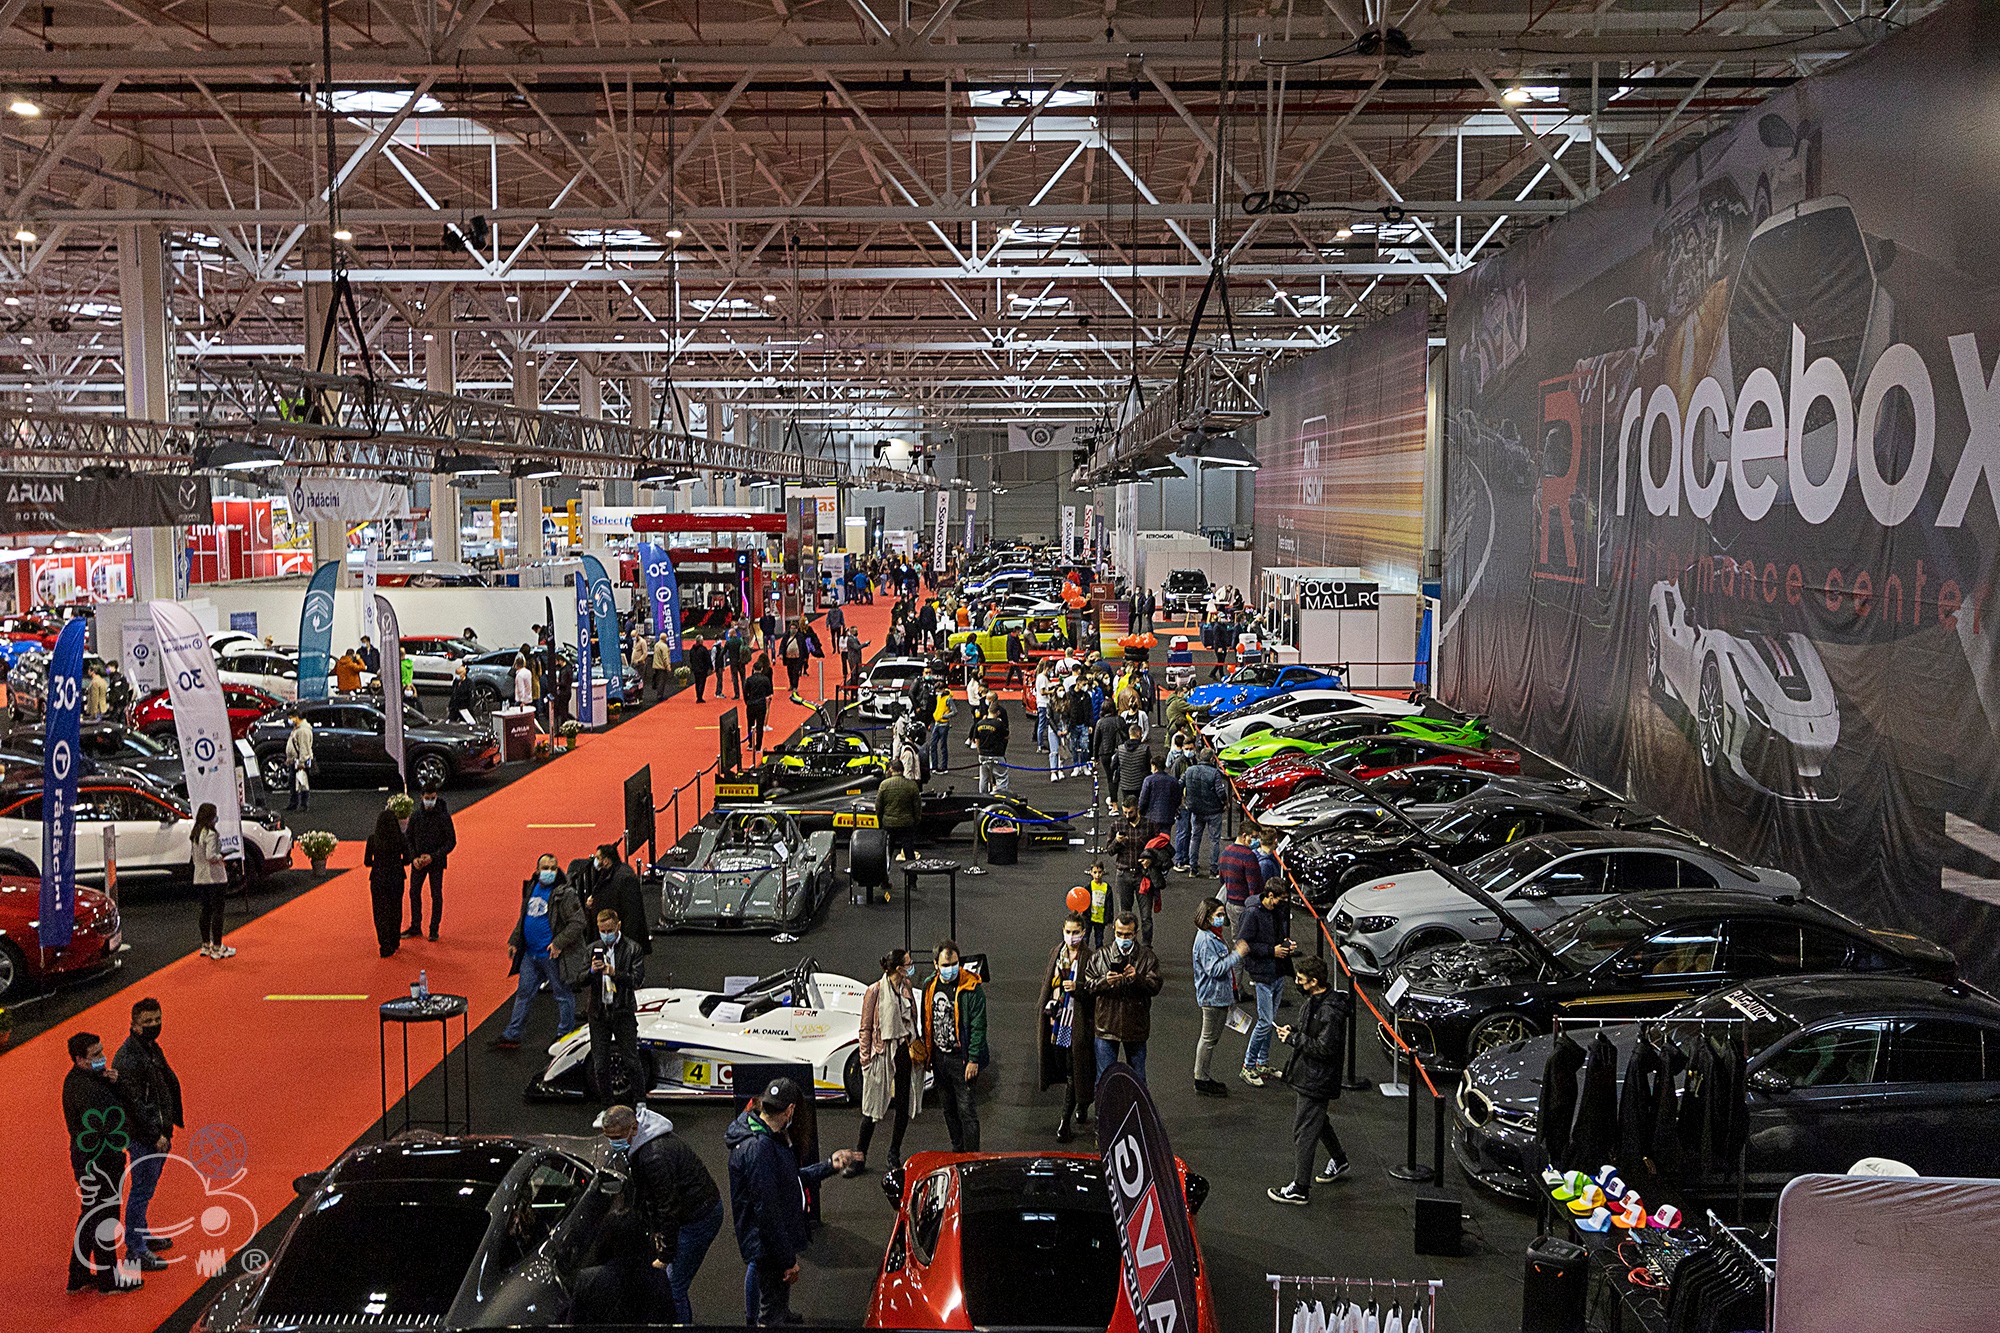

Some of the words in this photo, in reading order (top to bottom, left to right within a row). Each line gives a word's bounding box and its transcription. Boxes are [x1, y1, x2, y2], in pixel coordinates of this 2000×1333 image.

[1616, 323, 2000, 527] racebox
[6, 484, 64, 502] ARIAN
[592, 515, 622, 525] Select
[936, 506, 947, 568] SSANGYONG
[1825, 558, 1991, 635] center
[718, 786, 755, 795] PIRELLI
[690, 1064, 704, 1081] 4
